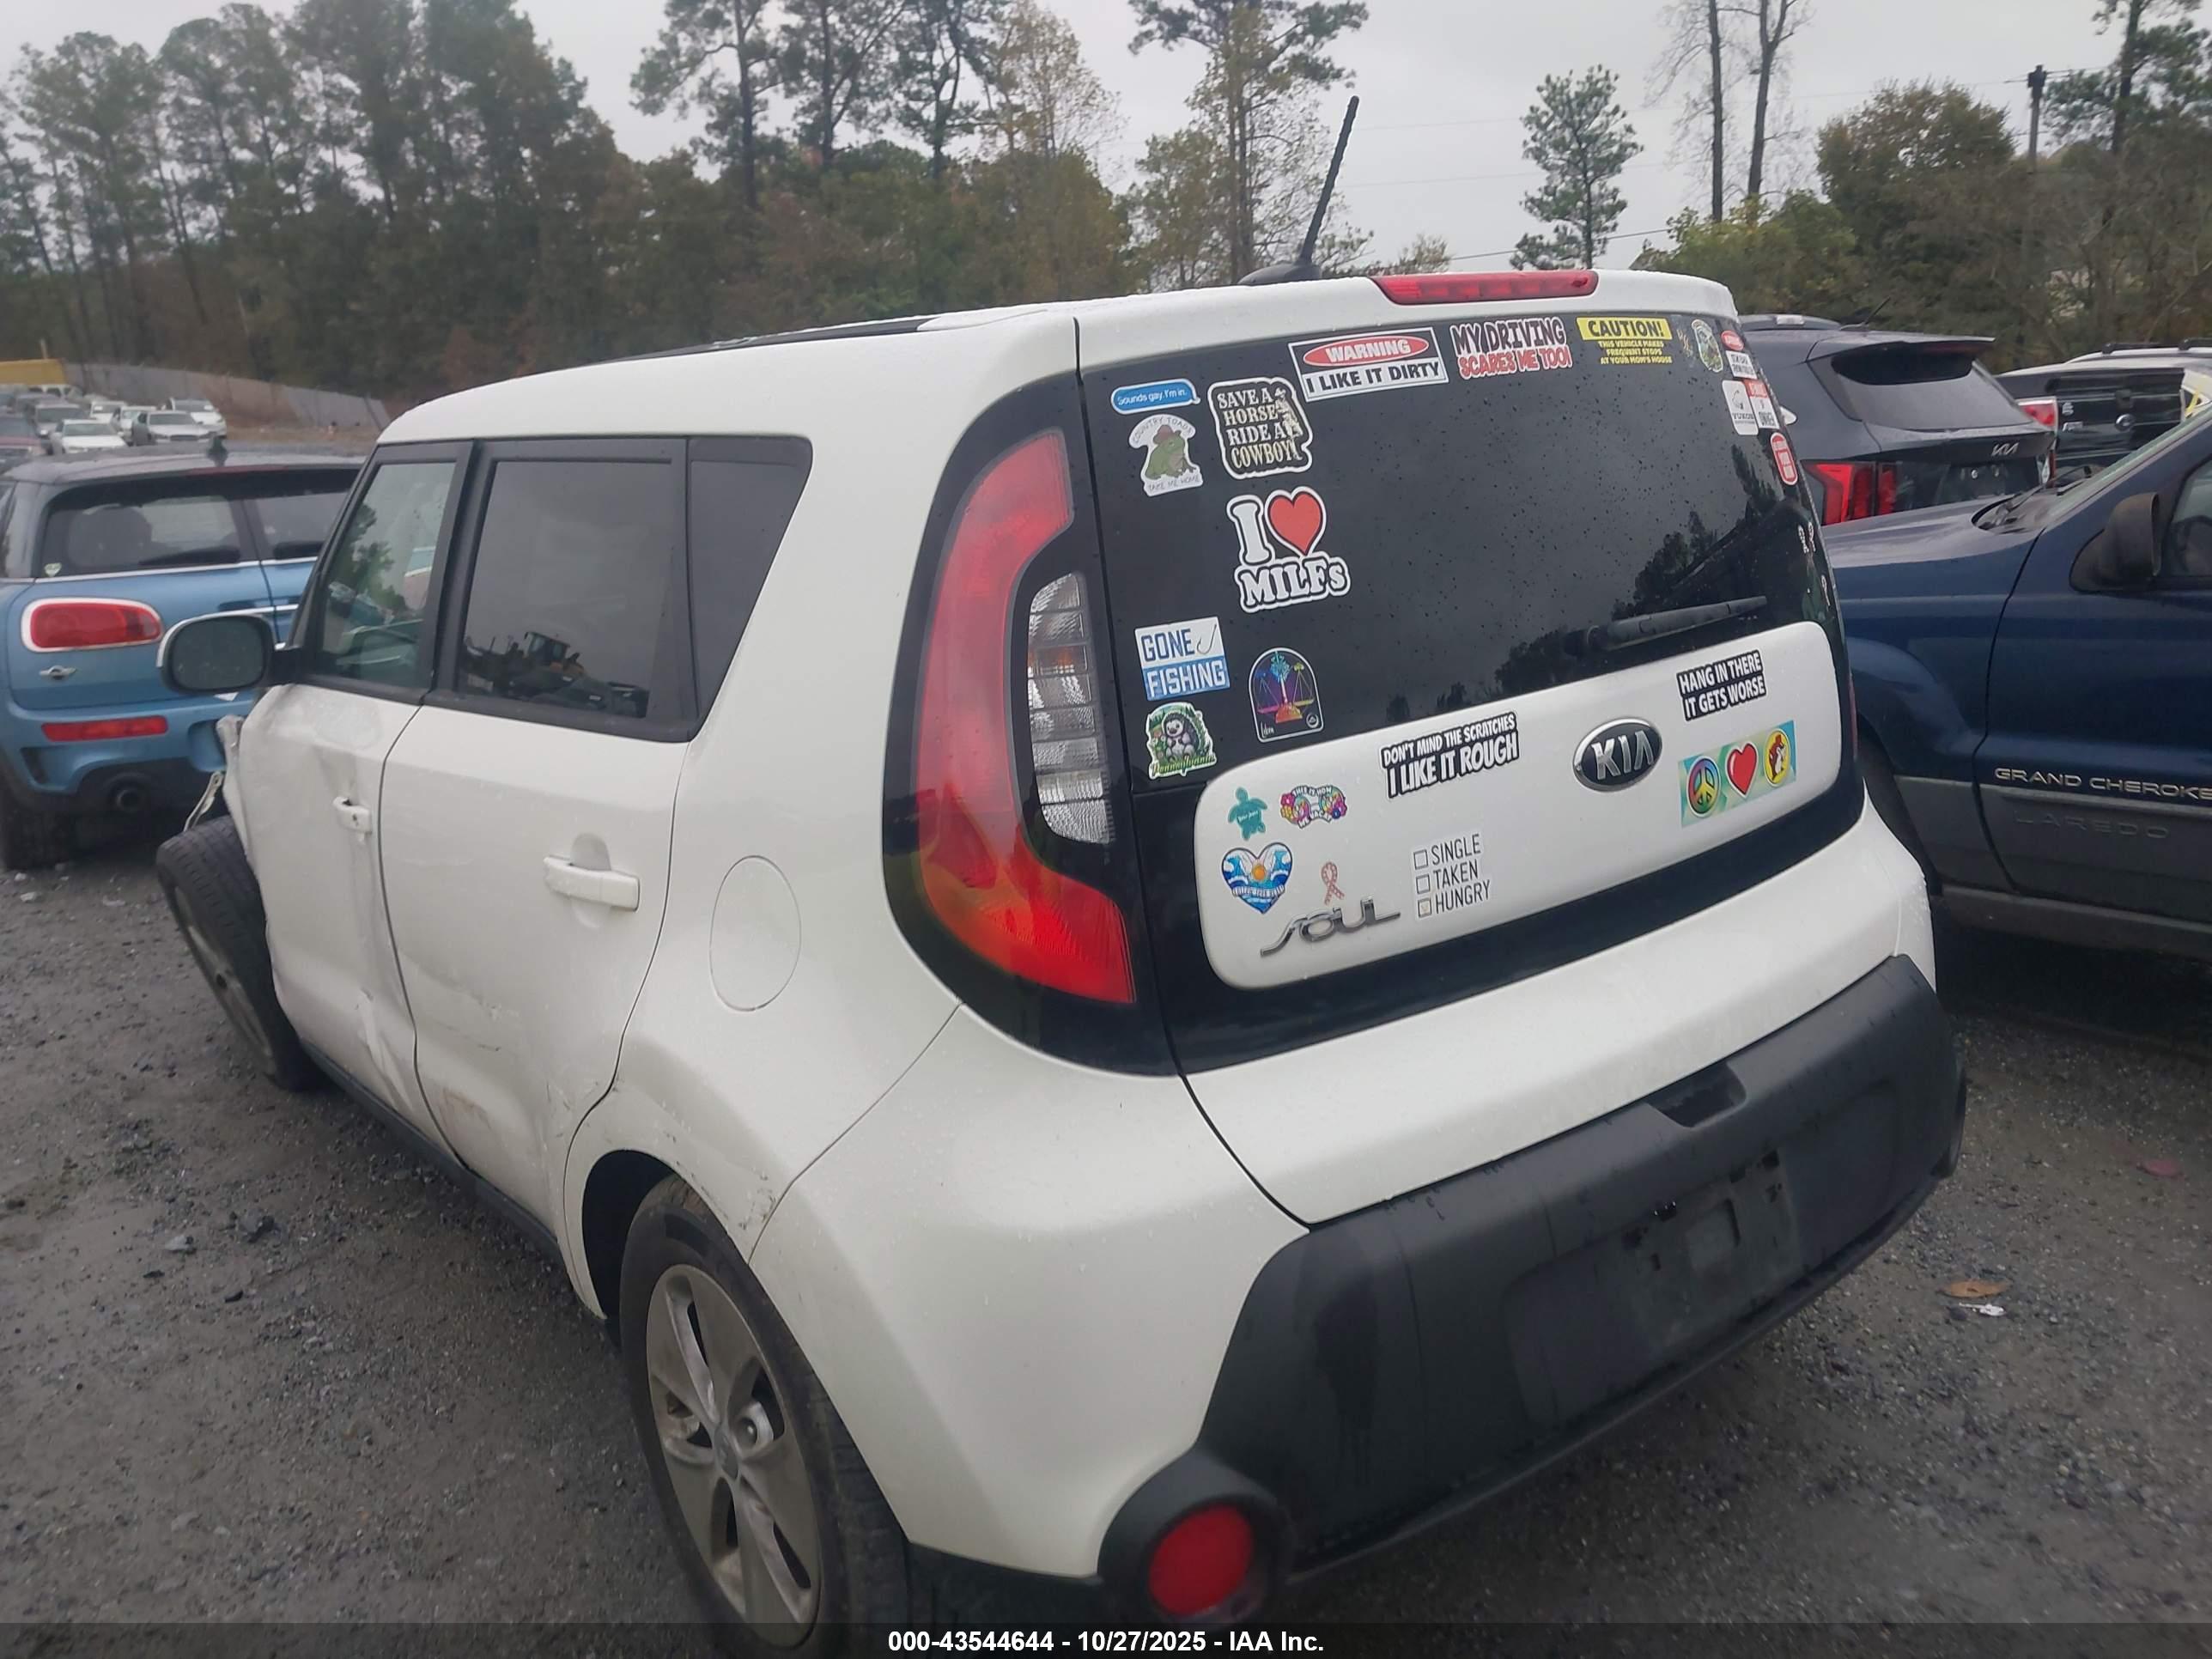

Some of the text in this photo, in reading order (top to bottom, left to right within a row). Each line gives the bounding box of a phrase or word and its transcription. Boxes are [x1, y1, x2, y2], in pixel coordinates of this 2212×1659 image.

[1451, 318, 1566, 356] MY DRIVING
[1588, 320, 1665, 337] CAUTION!
[1325, 339, 1412, 362] WARNING
[1459, 350, 1516, 378] SCARES
[1517, 349, 1539, 369] ME
[1306, 362, 1439, 392] I LIKE IT DIRTY
[1117, 393, 1148, 405] Sounds
[1217, 387, 1273, 409] SAVE A
[1223, 404, 1279, 426] HORSE
[1225, 422, 1287, 446] RIDE A
[1231, 439, 1292, 468] COWBOY
[1231, 501, 1271, 564] I
[1239, 556, 1346, 606] MILFs
[1140, 628, 1195, 662] GONE
[1146, 659, 1227, 698] FISHING
[1679, 652, 1762, 695] HANG IN THERE
[1685, 676, 1765, 719] IT GETS WORSE
[1383, 714, 1516, 767] DON'T MIND THE SCRATCHES
[1590, 729, 1654, 781] KIA
[1389, 732, 1518, 796] I LIKE IT ROUGH
[1994, 767, 2082, 787] GRAND
[1431, 833, 1481, 866] SINGLE
[1433, 859, 1479, 890] TAKEN
[1435, 879, 1491, 915] HUNGRY
